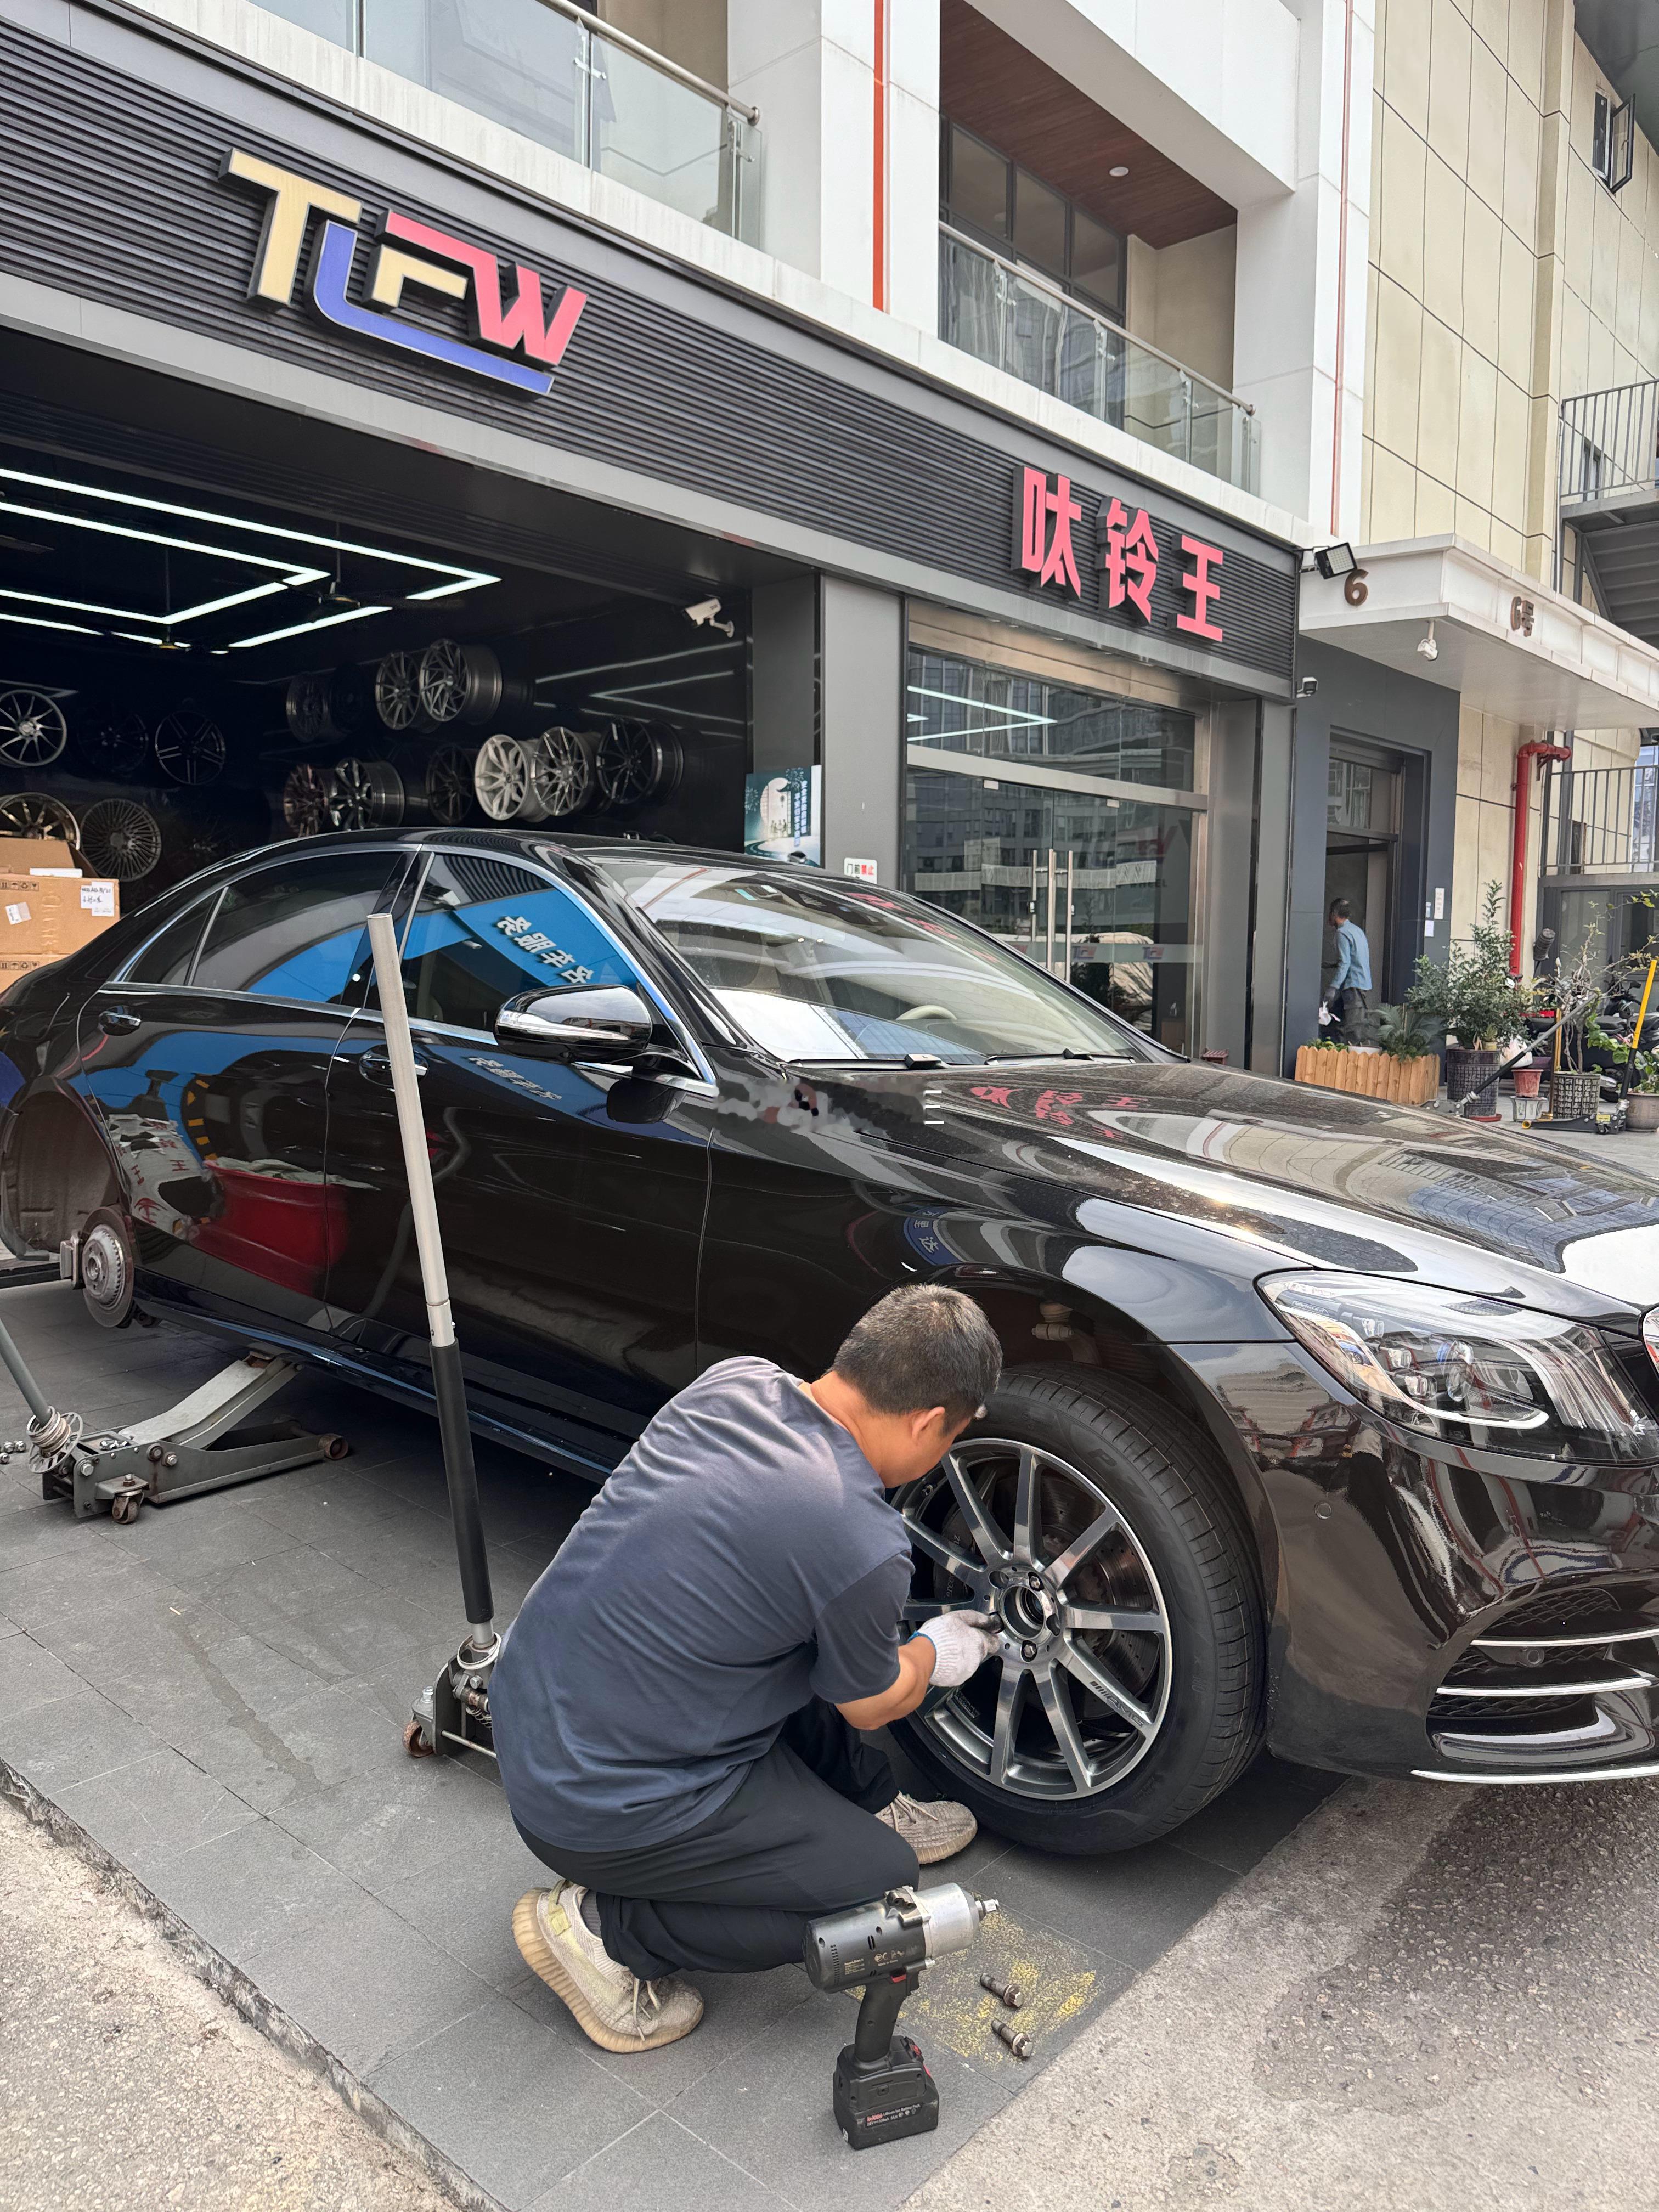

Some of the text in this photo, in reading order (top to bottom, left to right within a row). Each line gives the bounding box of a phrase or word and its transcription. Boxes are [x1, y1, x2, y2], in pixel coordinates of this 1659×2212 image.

[1013, 466, 1223, 642] 呔铃王
[1344, 569, 1369, 606] 6
[1510, 596, 1534, 637] 6号
